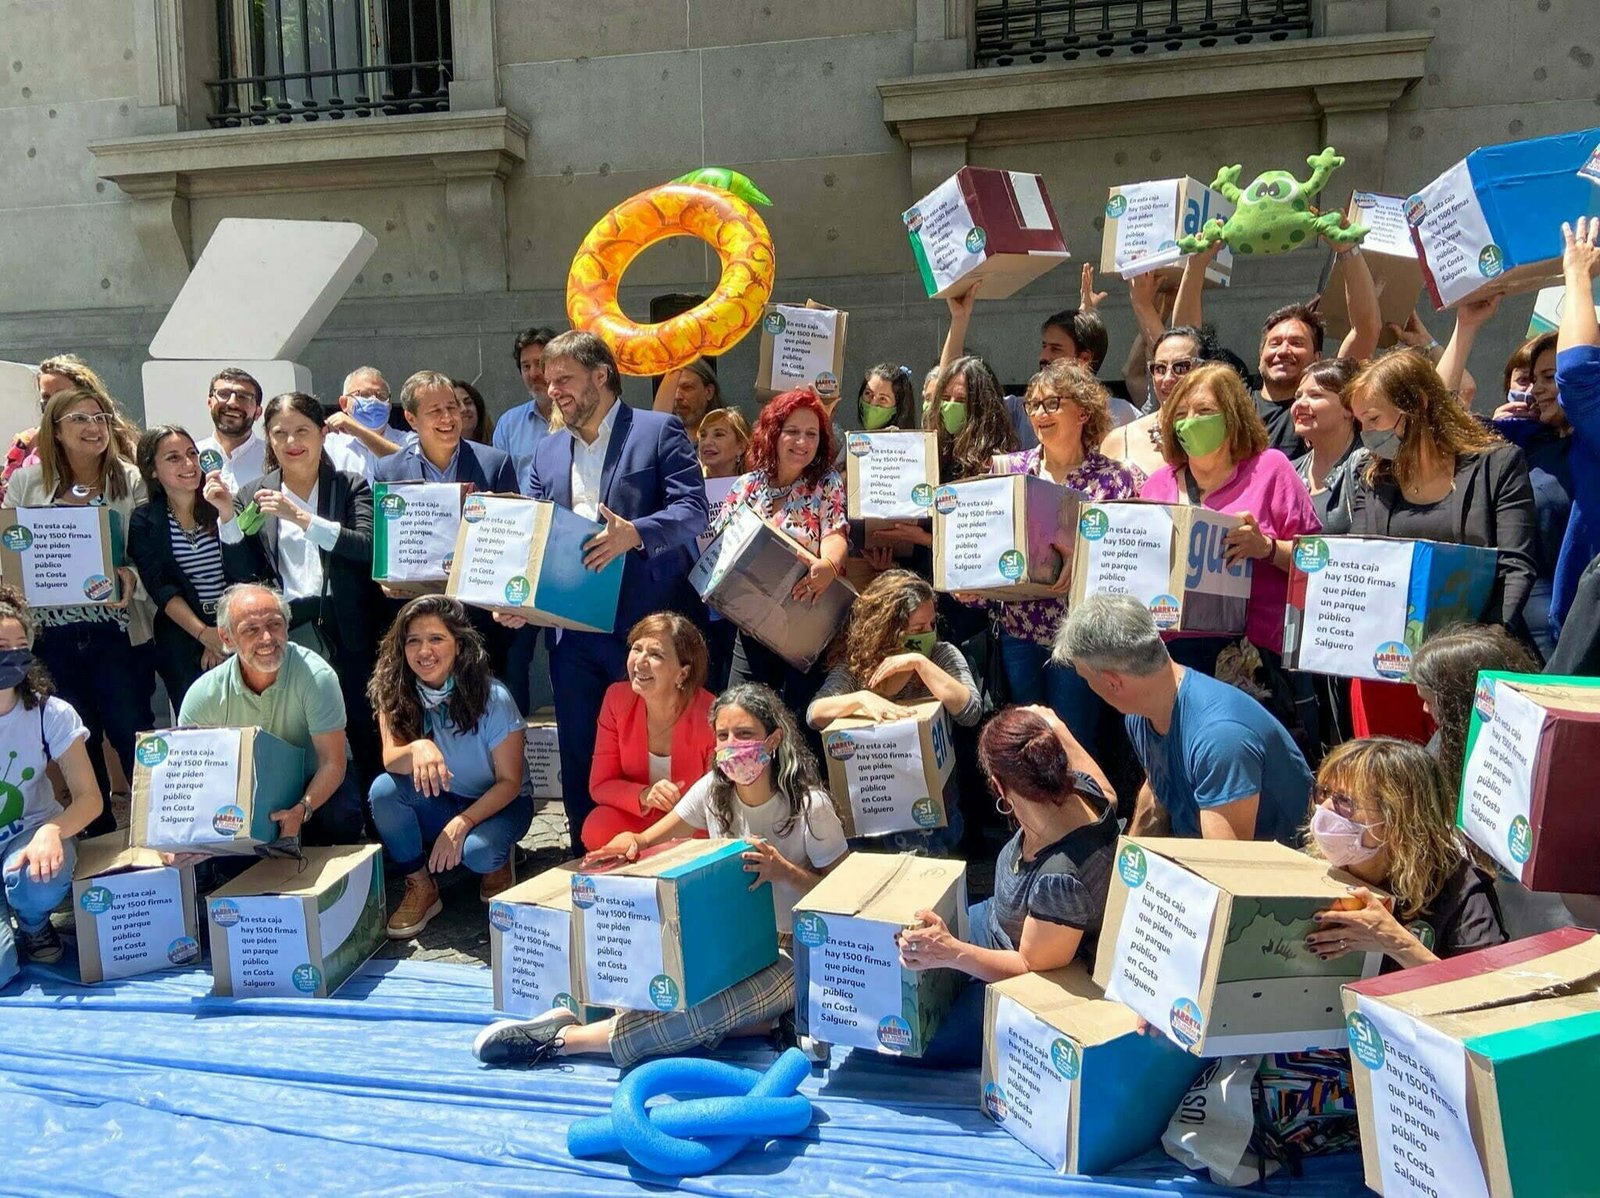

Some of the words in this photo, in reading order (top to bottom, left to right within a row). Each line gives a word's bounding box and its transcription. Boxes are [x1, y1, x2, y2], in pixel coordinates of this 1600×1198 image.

[1432, 201, 1444, 212] esta
[1444, 194, 1455, 204] caja
[1427, 218, 1438, 228] hay
[1437, 208, 1451, 221] 1500
[1451, 198, 1469, 213] firmas
[1441, 219, 1458, 234] piden
[1434, 241, 1442, 250] un
[1437, 244, 1458, 262] público
[1439, 264, 1447, 272] en
[1446, 254, 1464, 268] Costa
[1442, 266, 1467, 283] Salguero
[957, 500, 966, 508] En
[981, 499, 993, 507] caja
[969, 520, 987, 529] piden
[34, 532, 48, 540] hay
[965, 532, 987, 540] parque
[49, 542, 70, 550] piden
[955, 542, 978, 550] público
[963, 552, 981, 560] Costa
[1185, 520, 1252, 589] gu
[34, 561, 62, 570] público
[954, 563, 982, 572] Salguero
[1326, 557, 1339, 567] En
[1340, 561, 1360, 570] esta
[1361, 563, 1379, 573] caja
[35, 581, 68, 589] Salguero
[1324, 571, 1342, 583] hay
[1344, 574, 1365, 584] 1500
[1367, 576, 1396, 588] firmas
[1322, 586, 1339, 595] que
[1340, 587, 1366, 598] piden
[1333, 601, 1366, 612] parque
[1318, 612, 1351, 623] público
[1329, 626, 1354, 637] Costa
[1315, 637, 1354, 651] Salguero
[199, 748, 214, 757] caja
[167, 759, 182, 768] hay
[184, 759, 203, 767] 1500
[204, 759, 228, 767] firmas
[182, 770, 204, 779] piden
[163, 792, 192, 802] público
[173, 804, 195, 812] Costa
[160, 815, 195, 824] Salguero
[594, 895, 605, 903] En
[606, 897, 620, 905] esta
[621, 899, 635, 909] caja
[1145, 881, 1155, 893] En
[1155, 889, 1171, 904] esta
[1171, 900, 1186, 914] caja
[596, 907, 609, 918] hay
[610, 909, 627, 919] 1500
[628, 911, 651, 921] firmas
[1142, 894, 1156, 912] hay
[1156, 905, 1173, 922] 1500
[1174, 916, 1197, 939] firmas
[596, 922, 610, 930] que
[610, 922, 630, 932] piden
[1138, 912, 1152, 925] que
[1152, 921, 1173, 939] piden
[607, 936, 632, 946] parque
[825, 935, 837, 945] En
[838, 940, 856, 948] esta
[857, 943, 874, 952] caja
[1135, 926, 1145, 937] un
[1144, 933, 1171, 955] parque
[597, 946, 623, 957] público
[825, 948, 841, 960] hay
[842, 952, 863, 962] 1500
[864, 955, 891, 967] firmas
[1130, 941, 1157, 963] público
[607, 960, 627, 970] Costa
[824, 963, 841, 971] que
[842, 964, 865, 975] piden
[1127, 956, 1137, 966] en
[1138, 961, 1158, 981] Costa
[597, 972, 629, 984] Salguero
[836, 977, 866, 988] parque
[1123, 968, 1156, 997] Salguero
[823, 987, 854, 999] público
[834, 1002, 857, 1013] Costa
[821, 1013, 858, 1027] Salguero
[1382, 1039, 1397, 1056] En
[1397, 1051, 1418, 1070] esta
[1386, 1059, 1403, 1082] hay
[1405, 1072, 1429, 1095] 1500
[1430, 1088, 1459, 1119] firmas
[1388, 1083, 1406, 1101] que
[1408, 1095, 1436, 1119] piden
[1390, 1103, 1402, 1118] un
[1404, 1112, 1439, 1141] parque
[1391, 1123, 1427, 1152] público
[1393, 1144, 1405, 1158] en
[1406, 1151, 1435, 1178] Costa
[1394, 1162, 1438, 1198] Salguero
